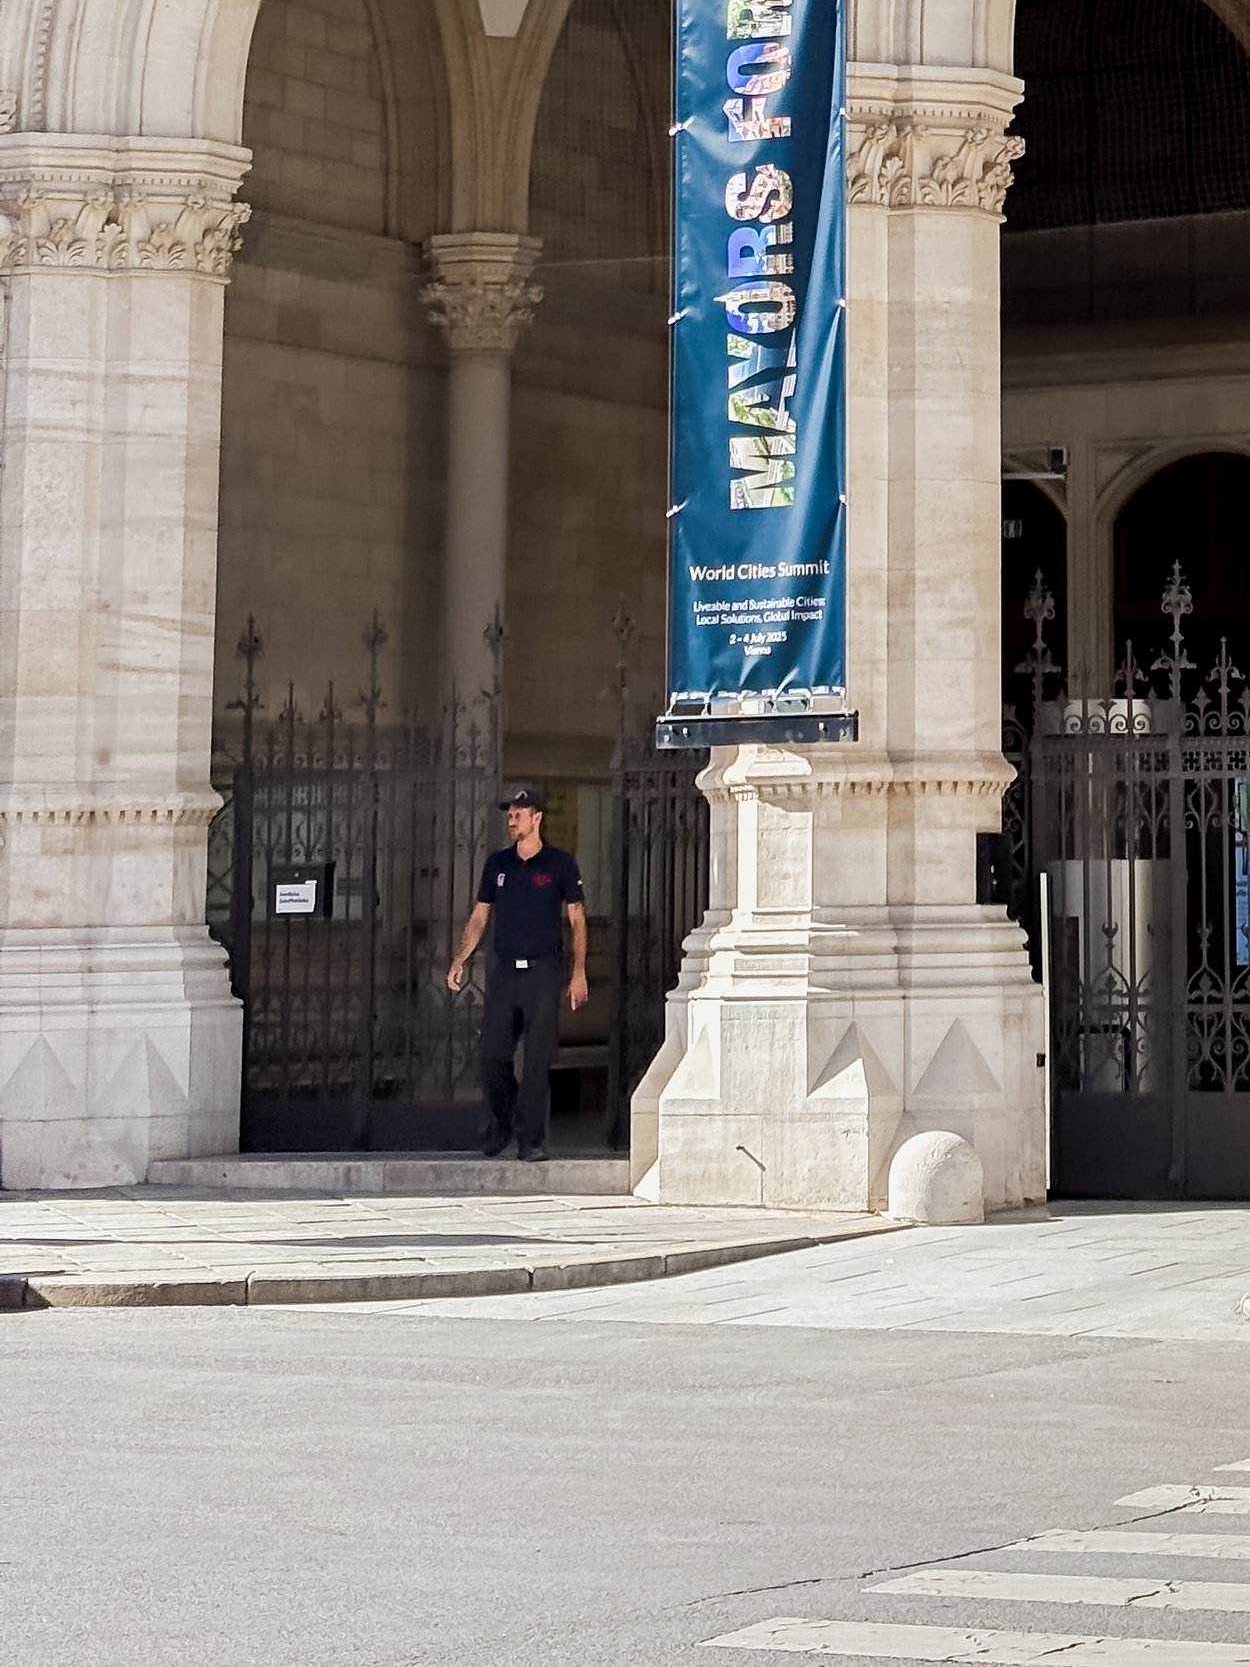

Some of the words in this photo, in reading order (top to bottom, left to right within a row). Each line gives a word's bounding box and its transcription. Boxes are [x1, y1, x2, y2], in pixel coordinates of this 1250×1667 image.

[716, 163, 797, 511] MAYORS
[689, 564, 735, 581] World
[737, 563, 776, 580] Cities
[778, 559, 830, 577] Summit
[693, 599, 730, 612] Liveable
[732, 599, 748, 611] and
[749, 597, 794, 610] Sustainable
[696, 614, 719, 625] Local
[763, 611, 790, 623] Global
[791, 609, 823, 622] Impact
[729, 634, 736, 645] 2
[743, 633, 749, 643] 4
